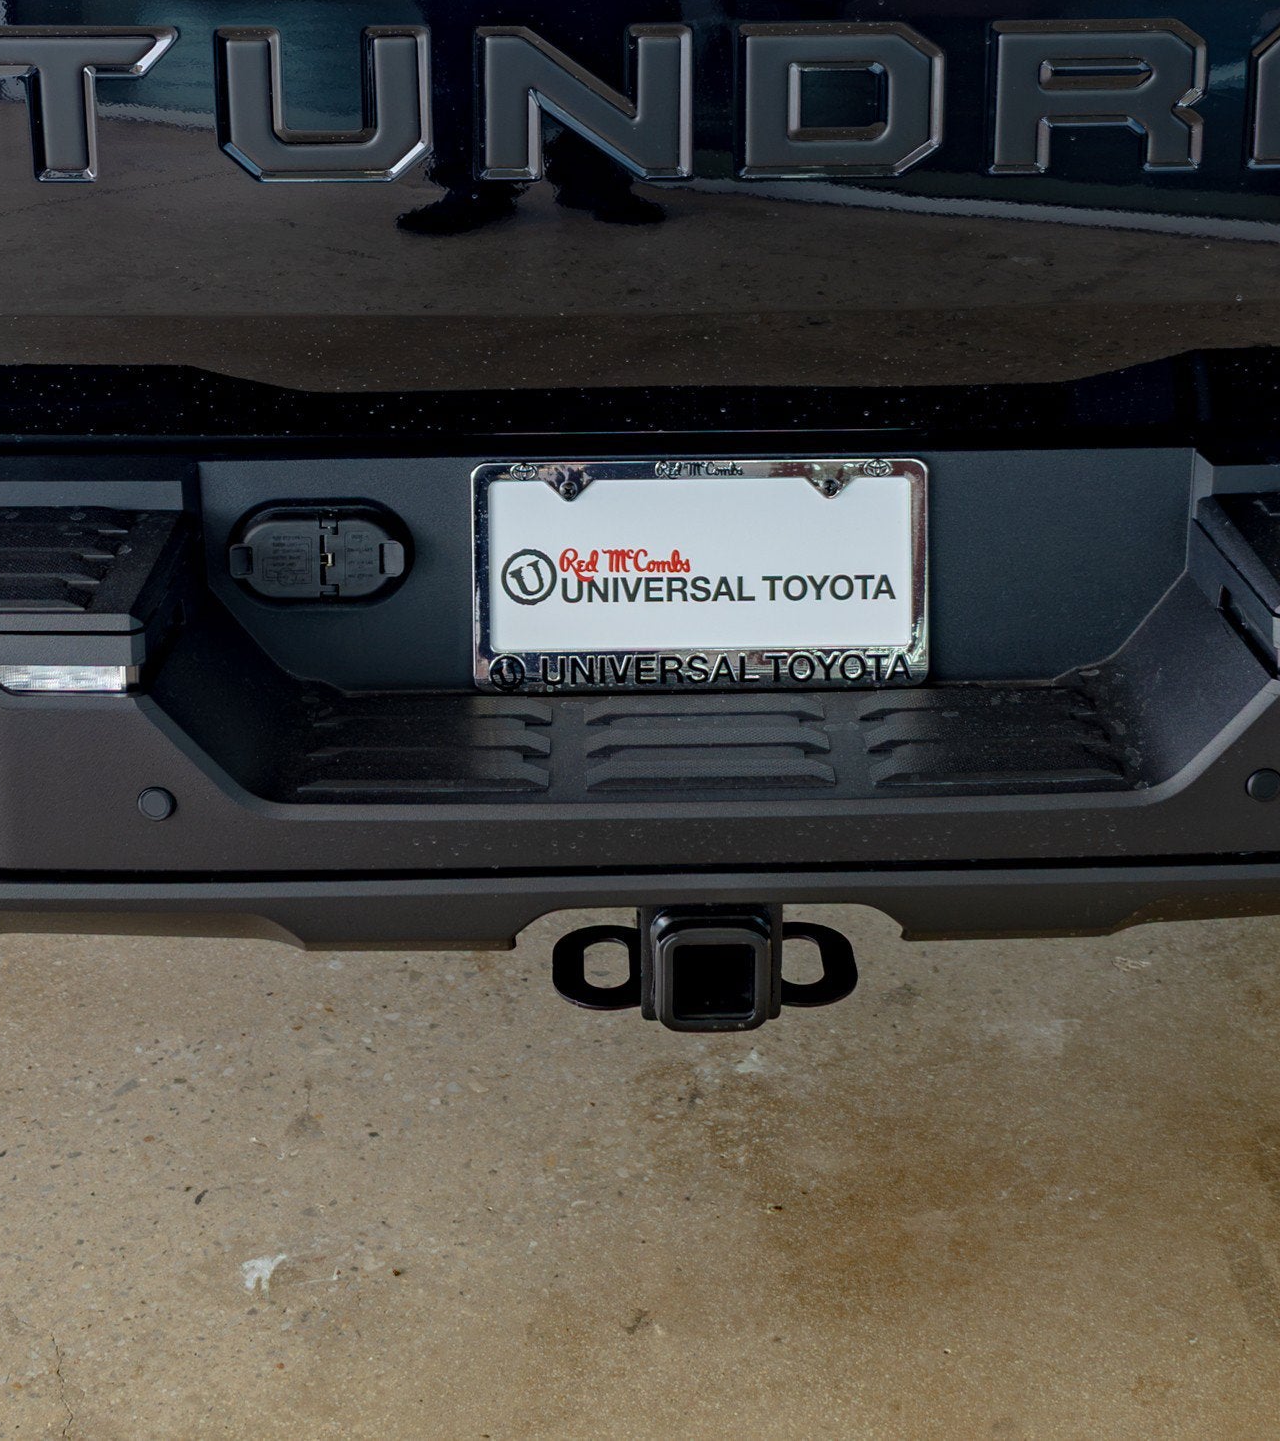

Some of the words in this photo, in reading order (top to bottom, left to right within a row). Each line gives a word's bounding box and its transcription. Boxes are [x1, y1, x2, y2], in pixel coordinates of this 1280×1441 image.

[655, 461, 681, 479] Red
[684, 461, 744, 476] McCombs
[559, 548, 600, 583] Red
[601, 548, 691, 574] McCombs
[561, 575, 755, 604] UNIVERSAL
[762, 574, 897, 601] TOYOTA
[540, 652, 761, 686] UNIVERSAL
[762, 650, 913, 683] TOYOTA
